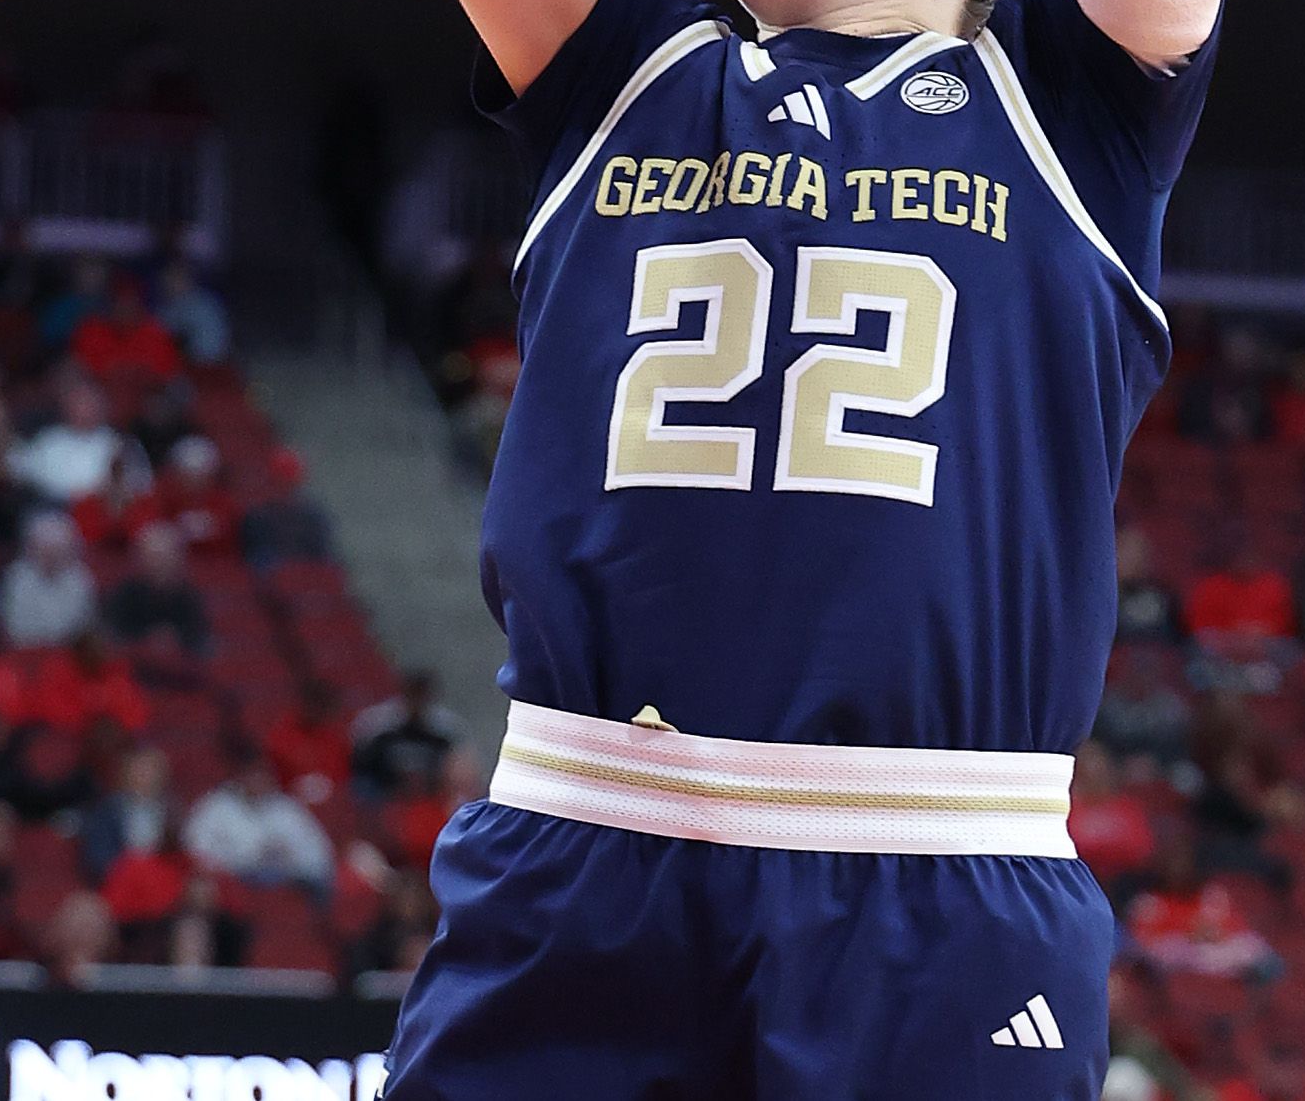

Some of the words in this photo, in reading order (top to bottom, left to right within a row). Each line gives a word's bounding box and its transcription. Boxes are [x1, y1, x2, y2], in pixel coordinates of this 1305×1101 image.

[912, 86, 964, 97] ACC
[596, 152, 828, 221] GEORGIA
[845, 169, 1010, 242] TECH
[604, 238, 957, 507] 22
